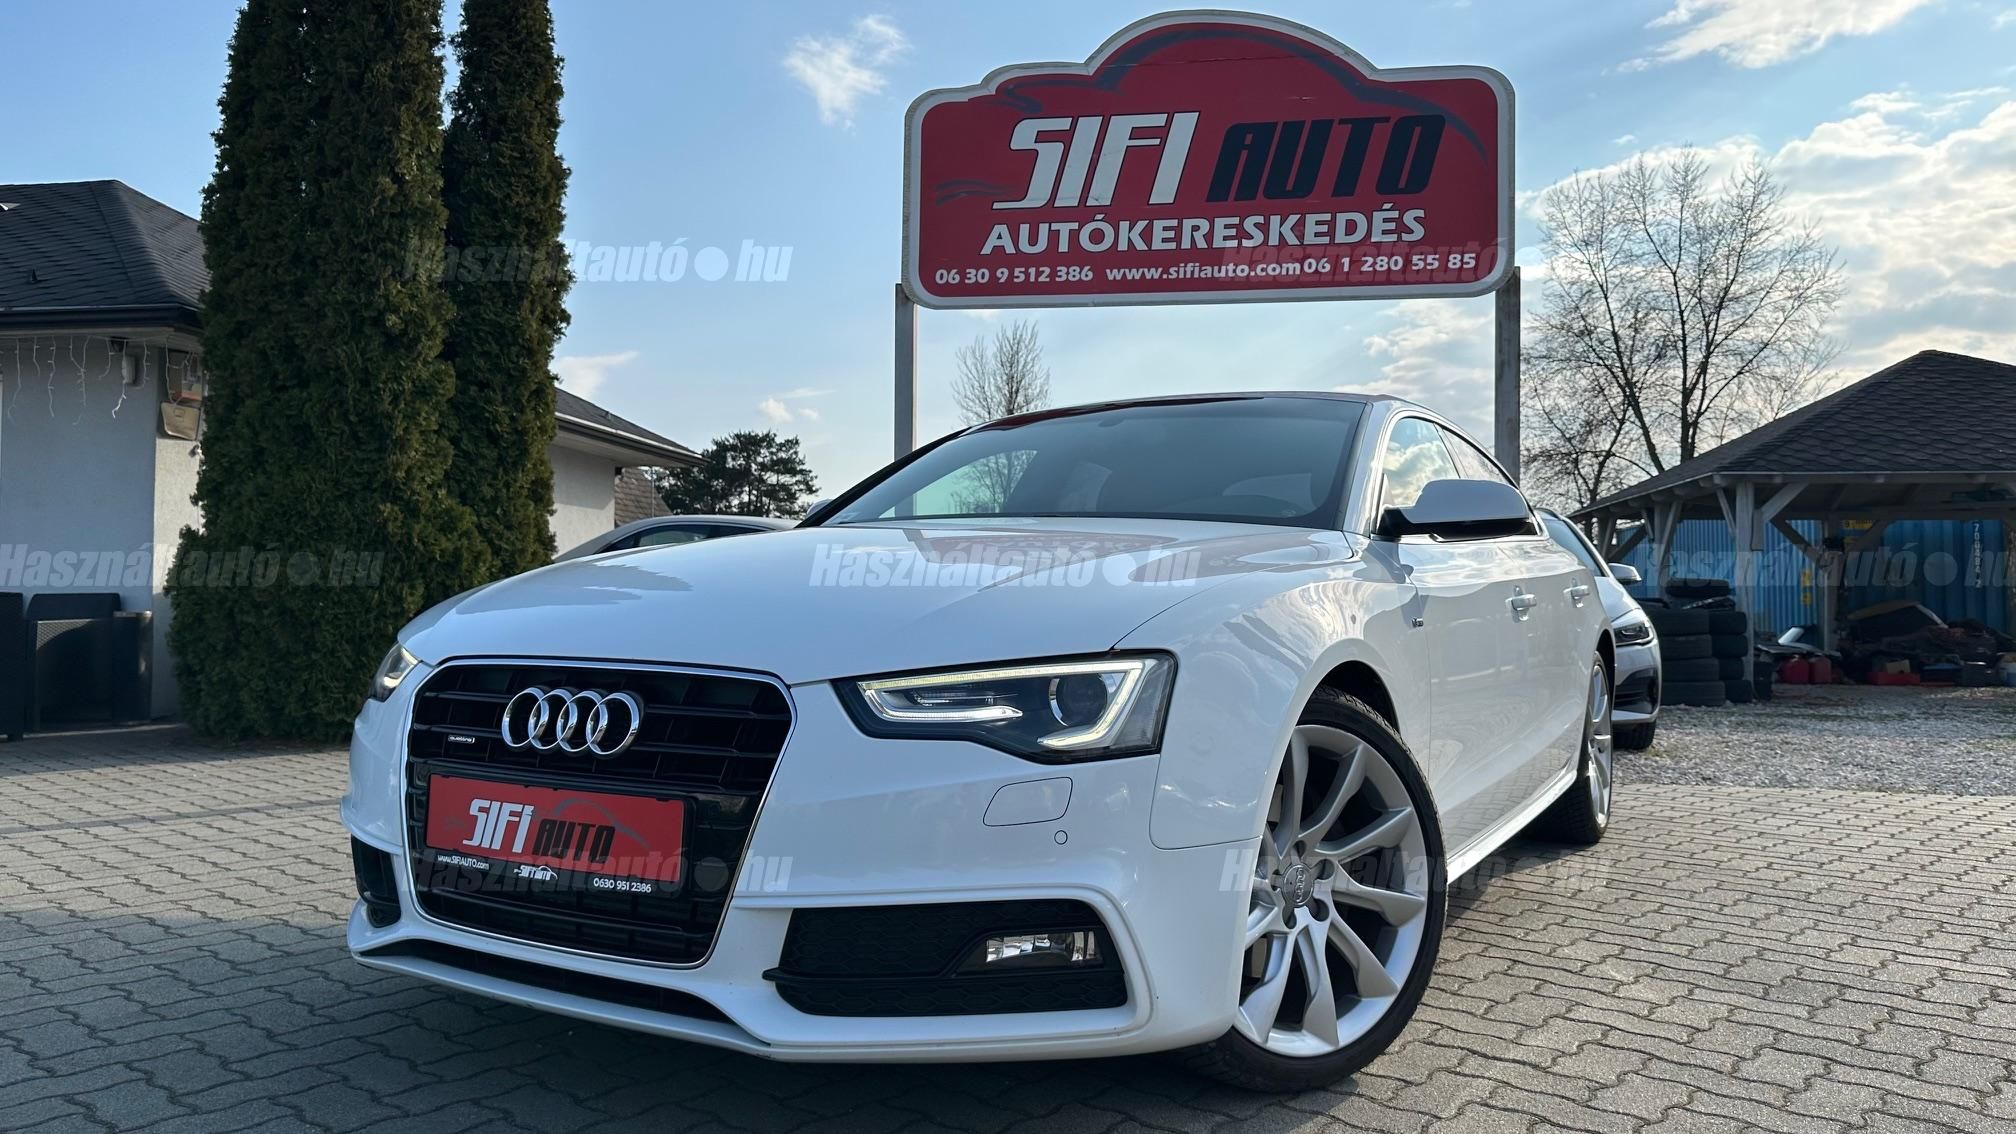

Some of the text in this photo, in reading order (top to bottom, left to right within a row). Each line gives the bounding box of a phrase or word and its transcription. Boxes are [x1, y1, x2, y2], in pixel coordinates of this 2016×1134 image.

[991, 110, 1447, 211] SIFI AUTO
[979, 202, 1426, 256] AUTÓKERESKEDÉS
[935, 253, 1476, 285] 06 30 9 512 386 www.sifiauto.com 06 1 280 55 85
[462, 798, 616, 864] SIFI AUTO
[593, 877, 615, 889] 0630
